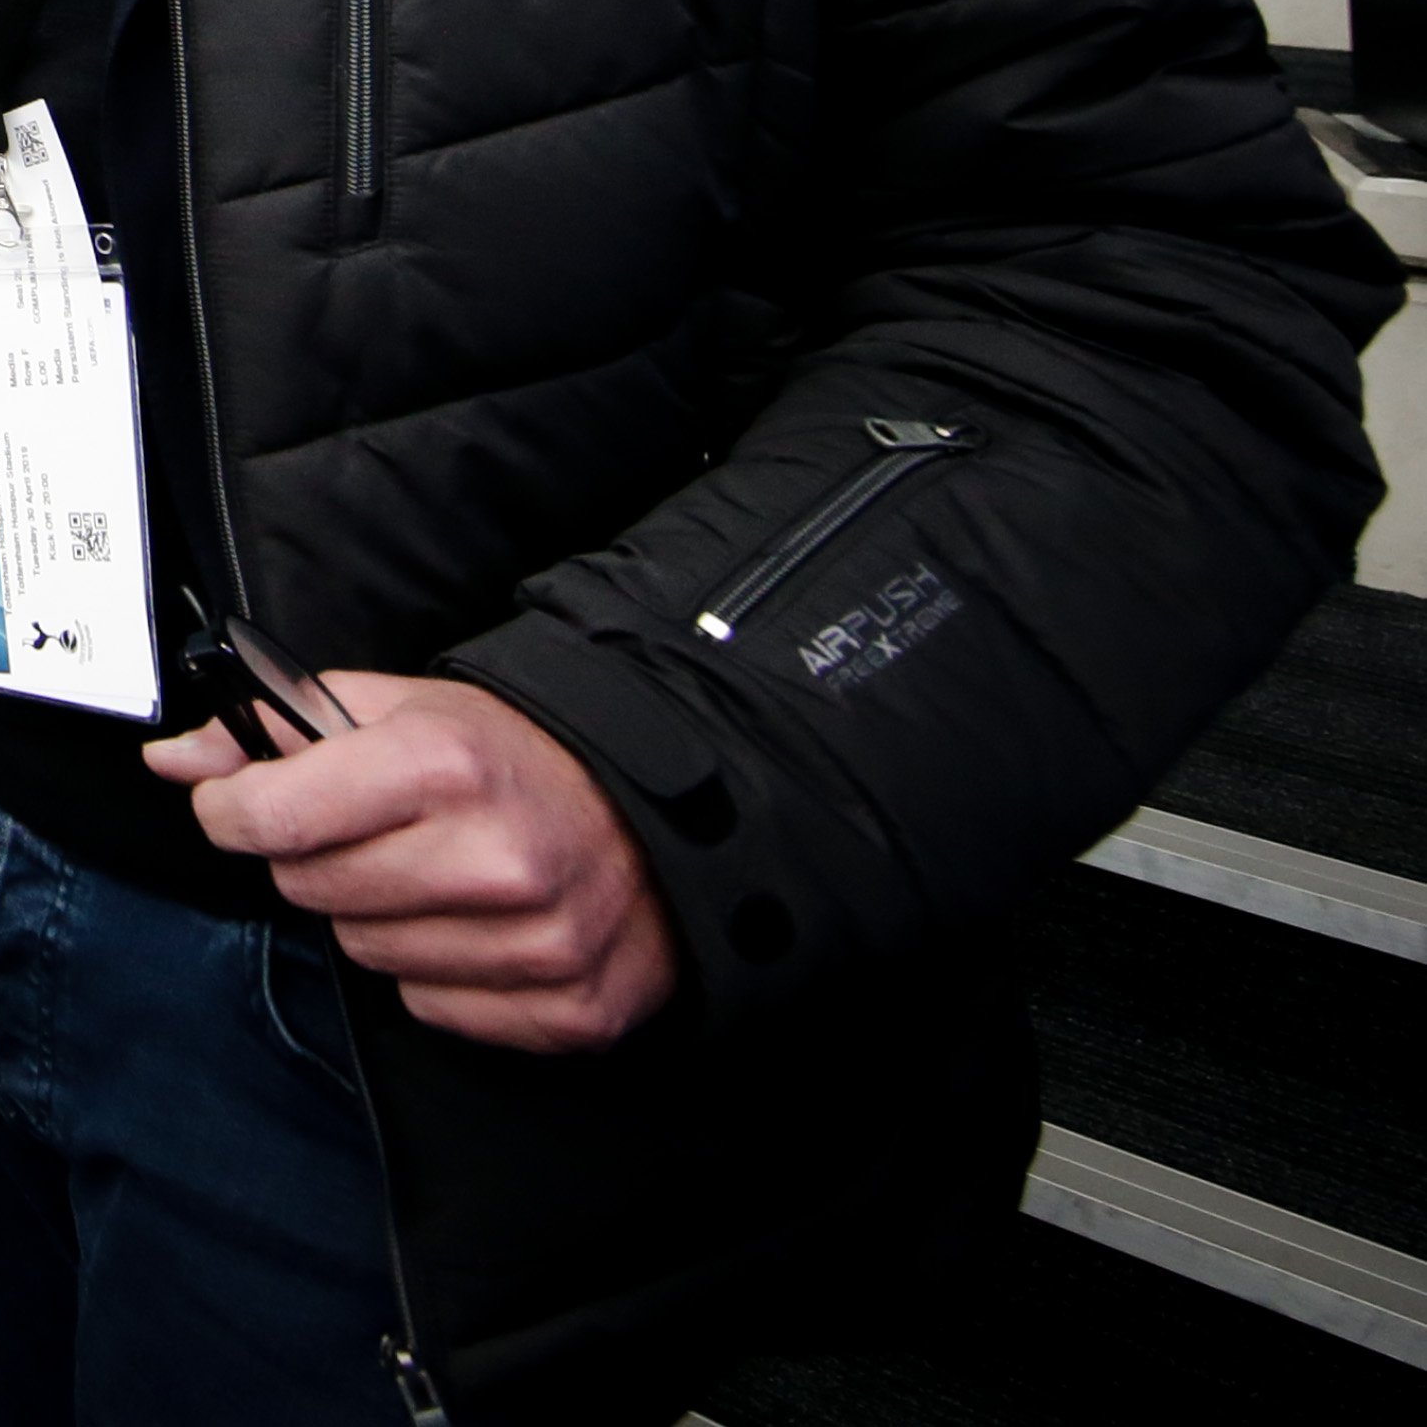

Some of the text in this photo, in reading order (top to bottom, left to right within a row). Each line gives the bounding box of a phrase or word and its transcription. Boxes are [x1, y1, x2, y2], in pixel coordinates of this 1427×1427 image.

[15, 284, 24, 309] Seat
[7, 353, 17, 388] Media
[24, 360, 33, 386] Row
[53, 348, 64, 384] Media
[65, 322, 79, 383] Persistent
[23, 477, 33, 504] April
[3, 432, 25, 596] Tottenham Hotspur Stadium
[41, 473, 57, 561] Kick Off 20:00
[29, 526, 41, 576] Tuesday
[797, 561, 940, 677] AIRPUSH
